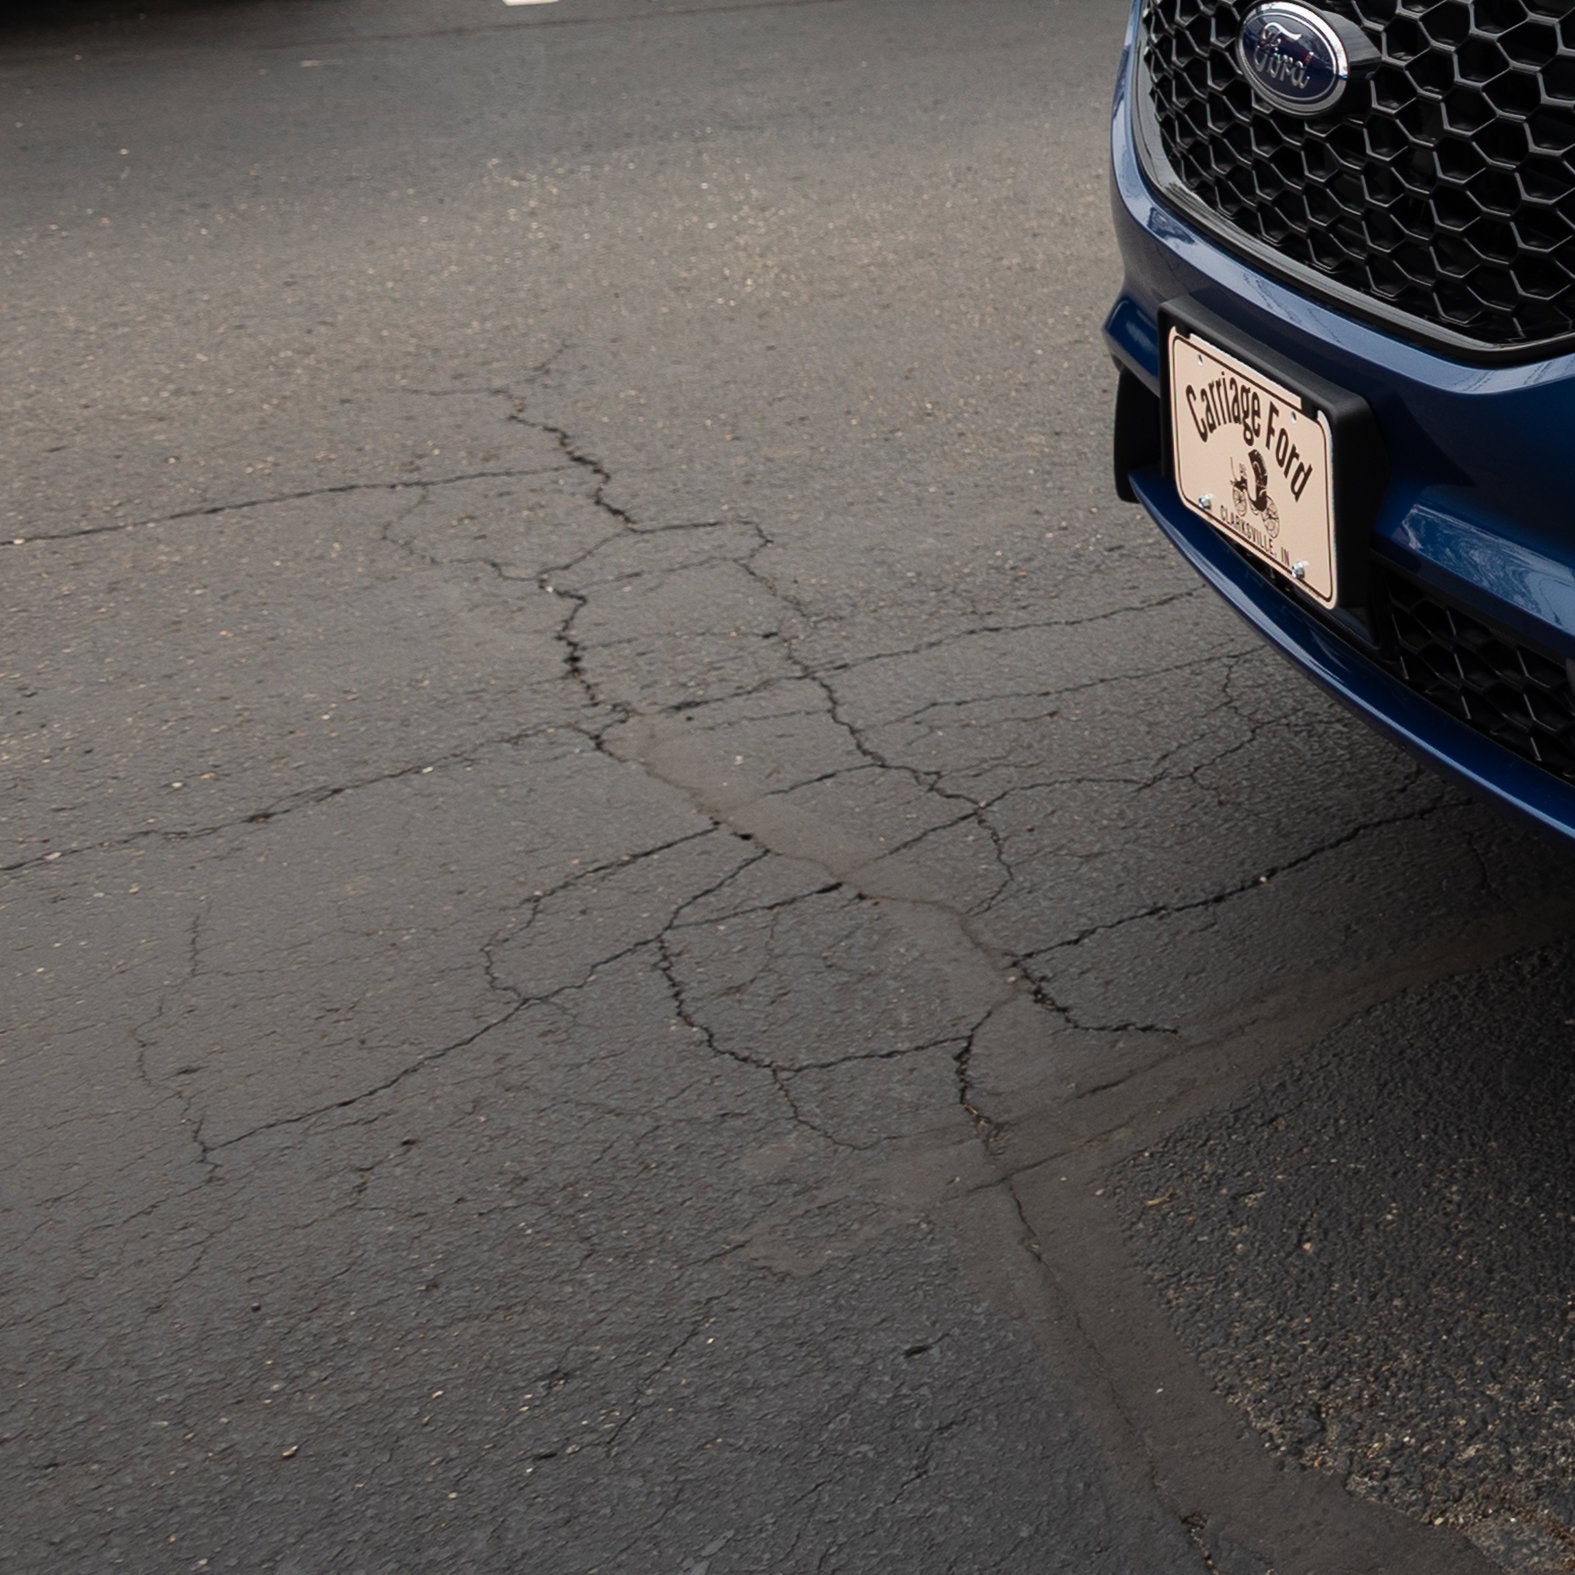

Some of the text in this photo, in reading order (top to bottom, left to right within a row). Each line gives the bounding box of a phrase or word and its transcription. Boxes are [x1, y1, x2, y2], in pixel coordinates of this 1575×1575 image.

[1254, 22, 1312, 89] Ford
[1185, 371, 1313, 503] Carriage Ford
[1219, 504, 1291, 567] CLARKSVILLE, IN
